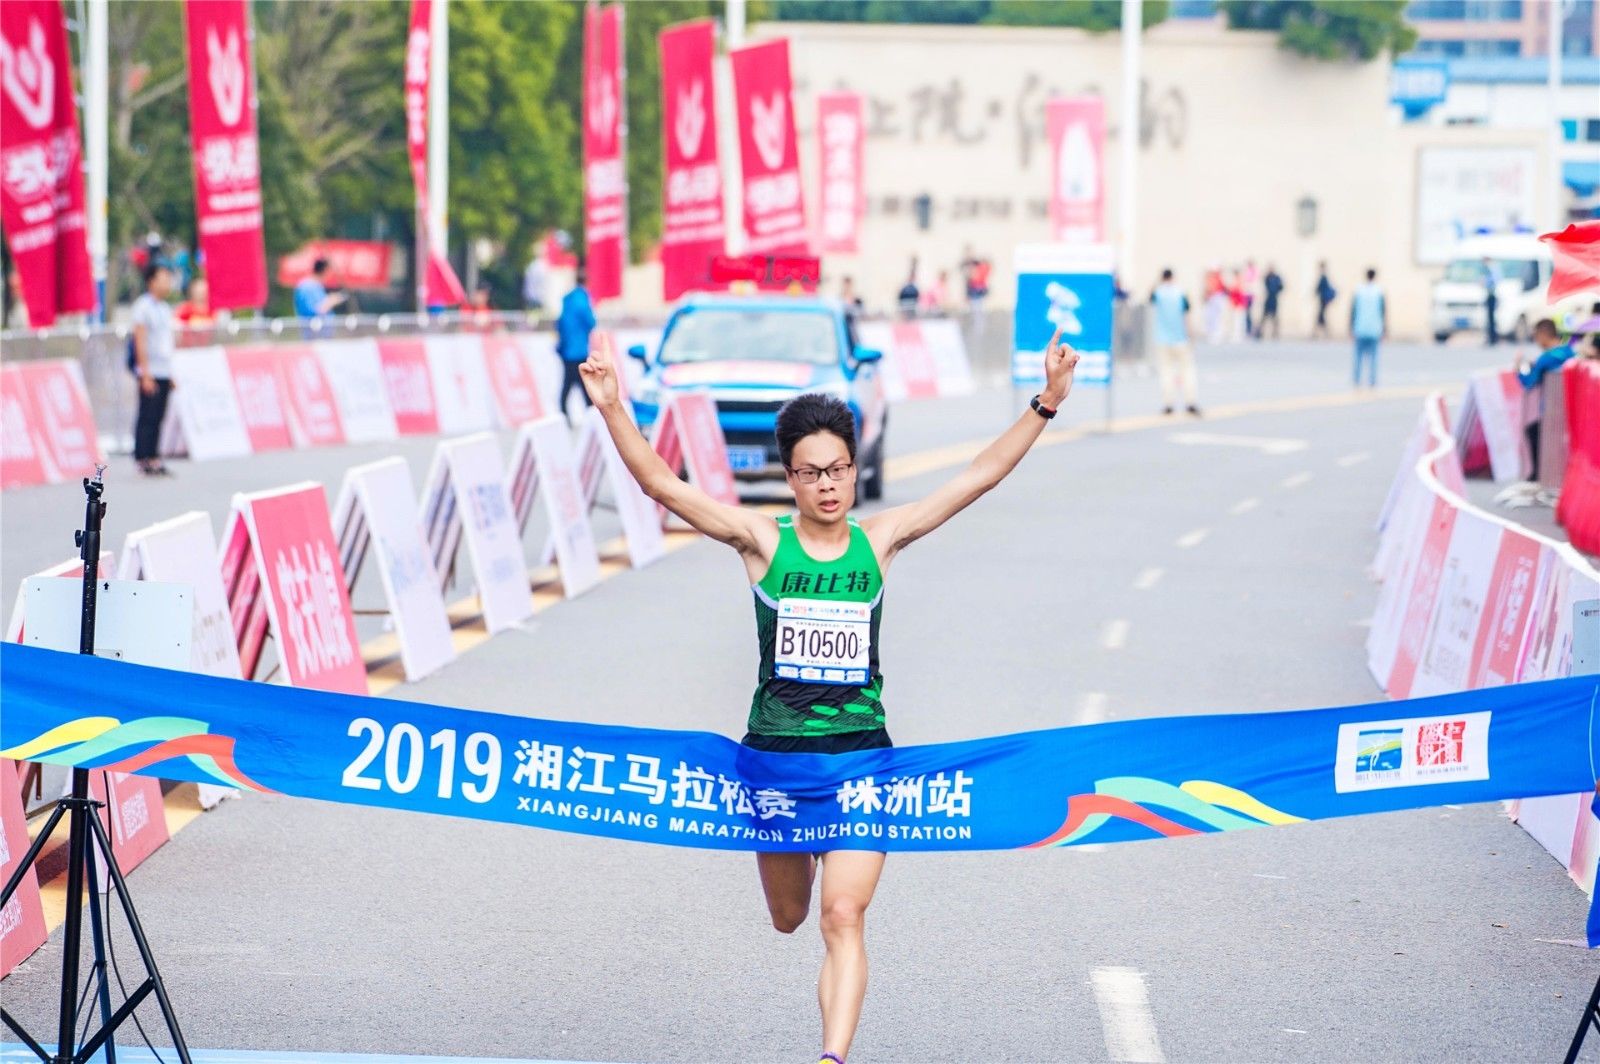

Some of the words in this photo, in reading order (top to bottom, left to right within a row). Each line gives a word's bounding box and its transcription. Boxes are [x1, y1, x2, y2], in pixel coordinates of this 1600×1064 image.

[781, 571, 871, 594] 康比特
[781, 626, 858, 660] B10500
[341, 717, 503, 804] 2019
[512, 739, 797, 820] 湘江马拉松赛
[836, 770, 974, 818] 株洲站
[516, 796, 658, 829] XIANGJIANG
[669, 815, 783, 842] MARATHON
[792, 821, 883, 843] ZHUZHOU
[887, 823, 972, 840] STATION
